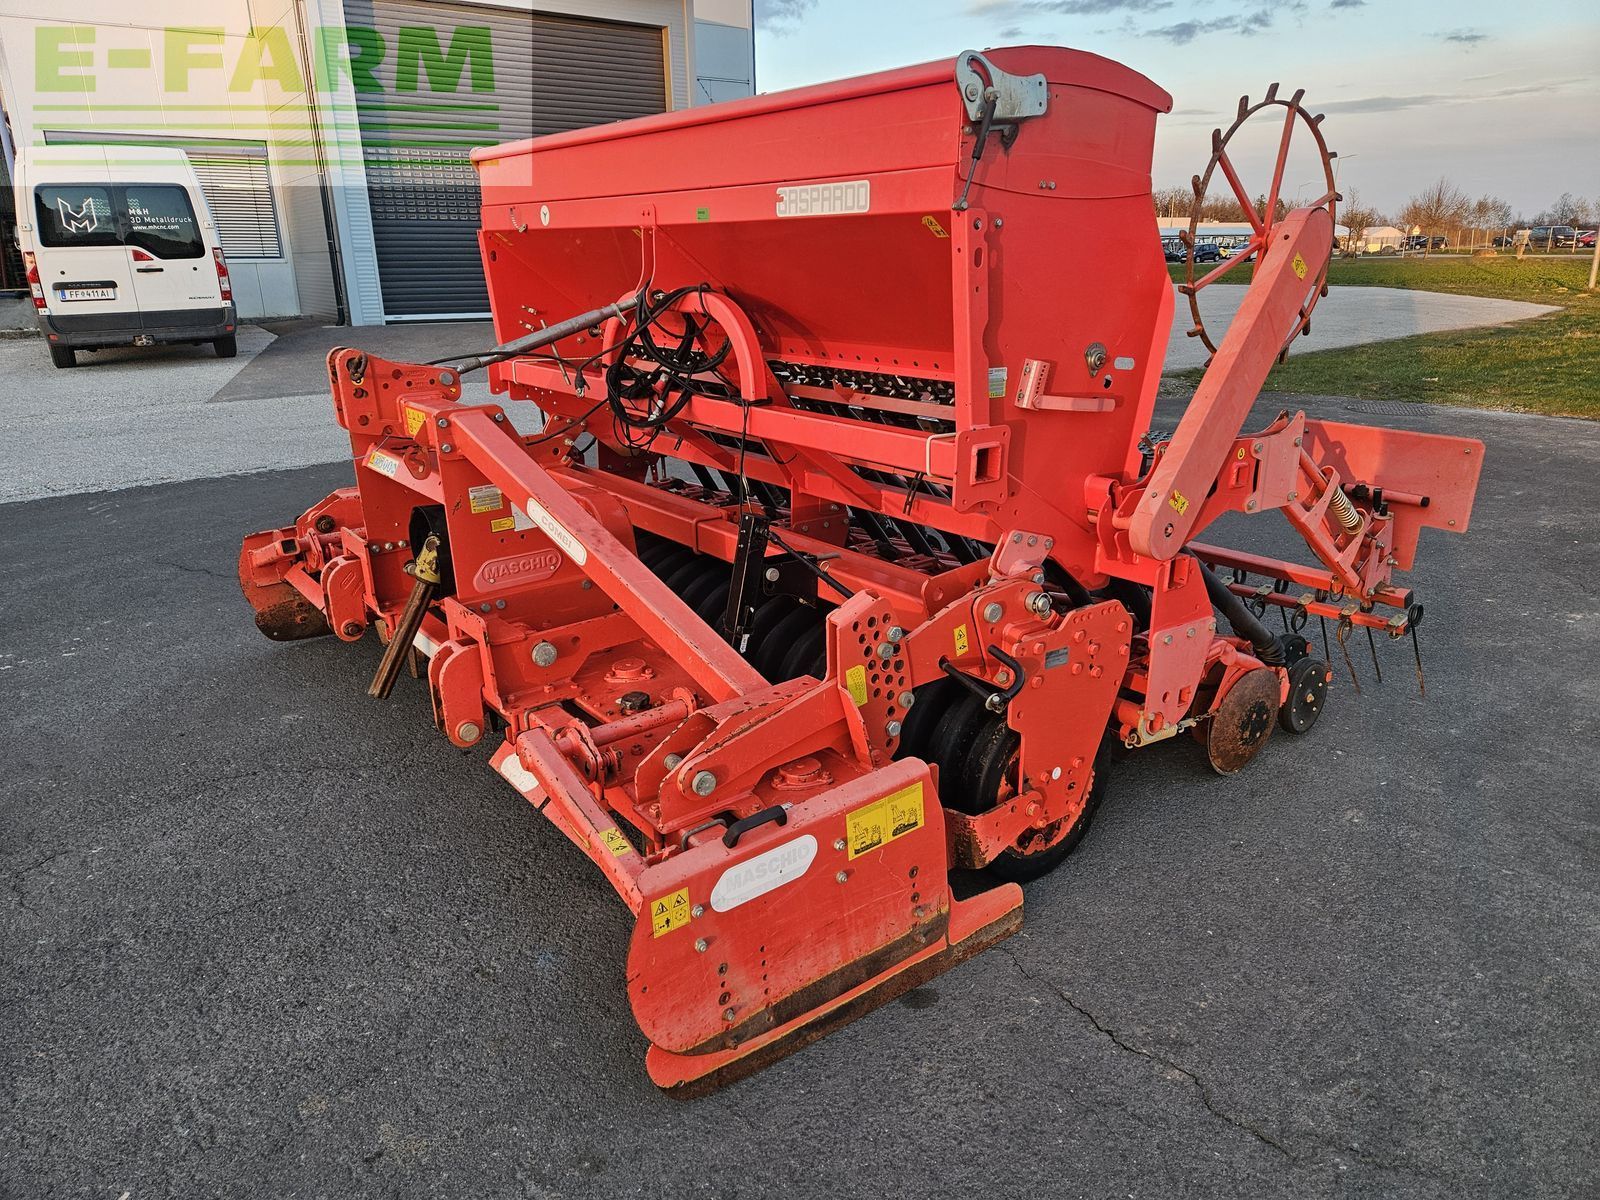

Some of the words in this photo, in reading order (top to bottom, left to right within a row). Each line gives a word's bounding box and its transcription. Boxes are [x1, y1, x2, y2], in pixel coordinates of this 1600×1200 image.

[128, 208, 149, 216] M&H
[130, 216, 142, 224] 3D
[541, 515, 573, 549] COMBI
[485, 554, 557, 580] MASCHIO
[726, 844, 811, 891] MASCHIO
